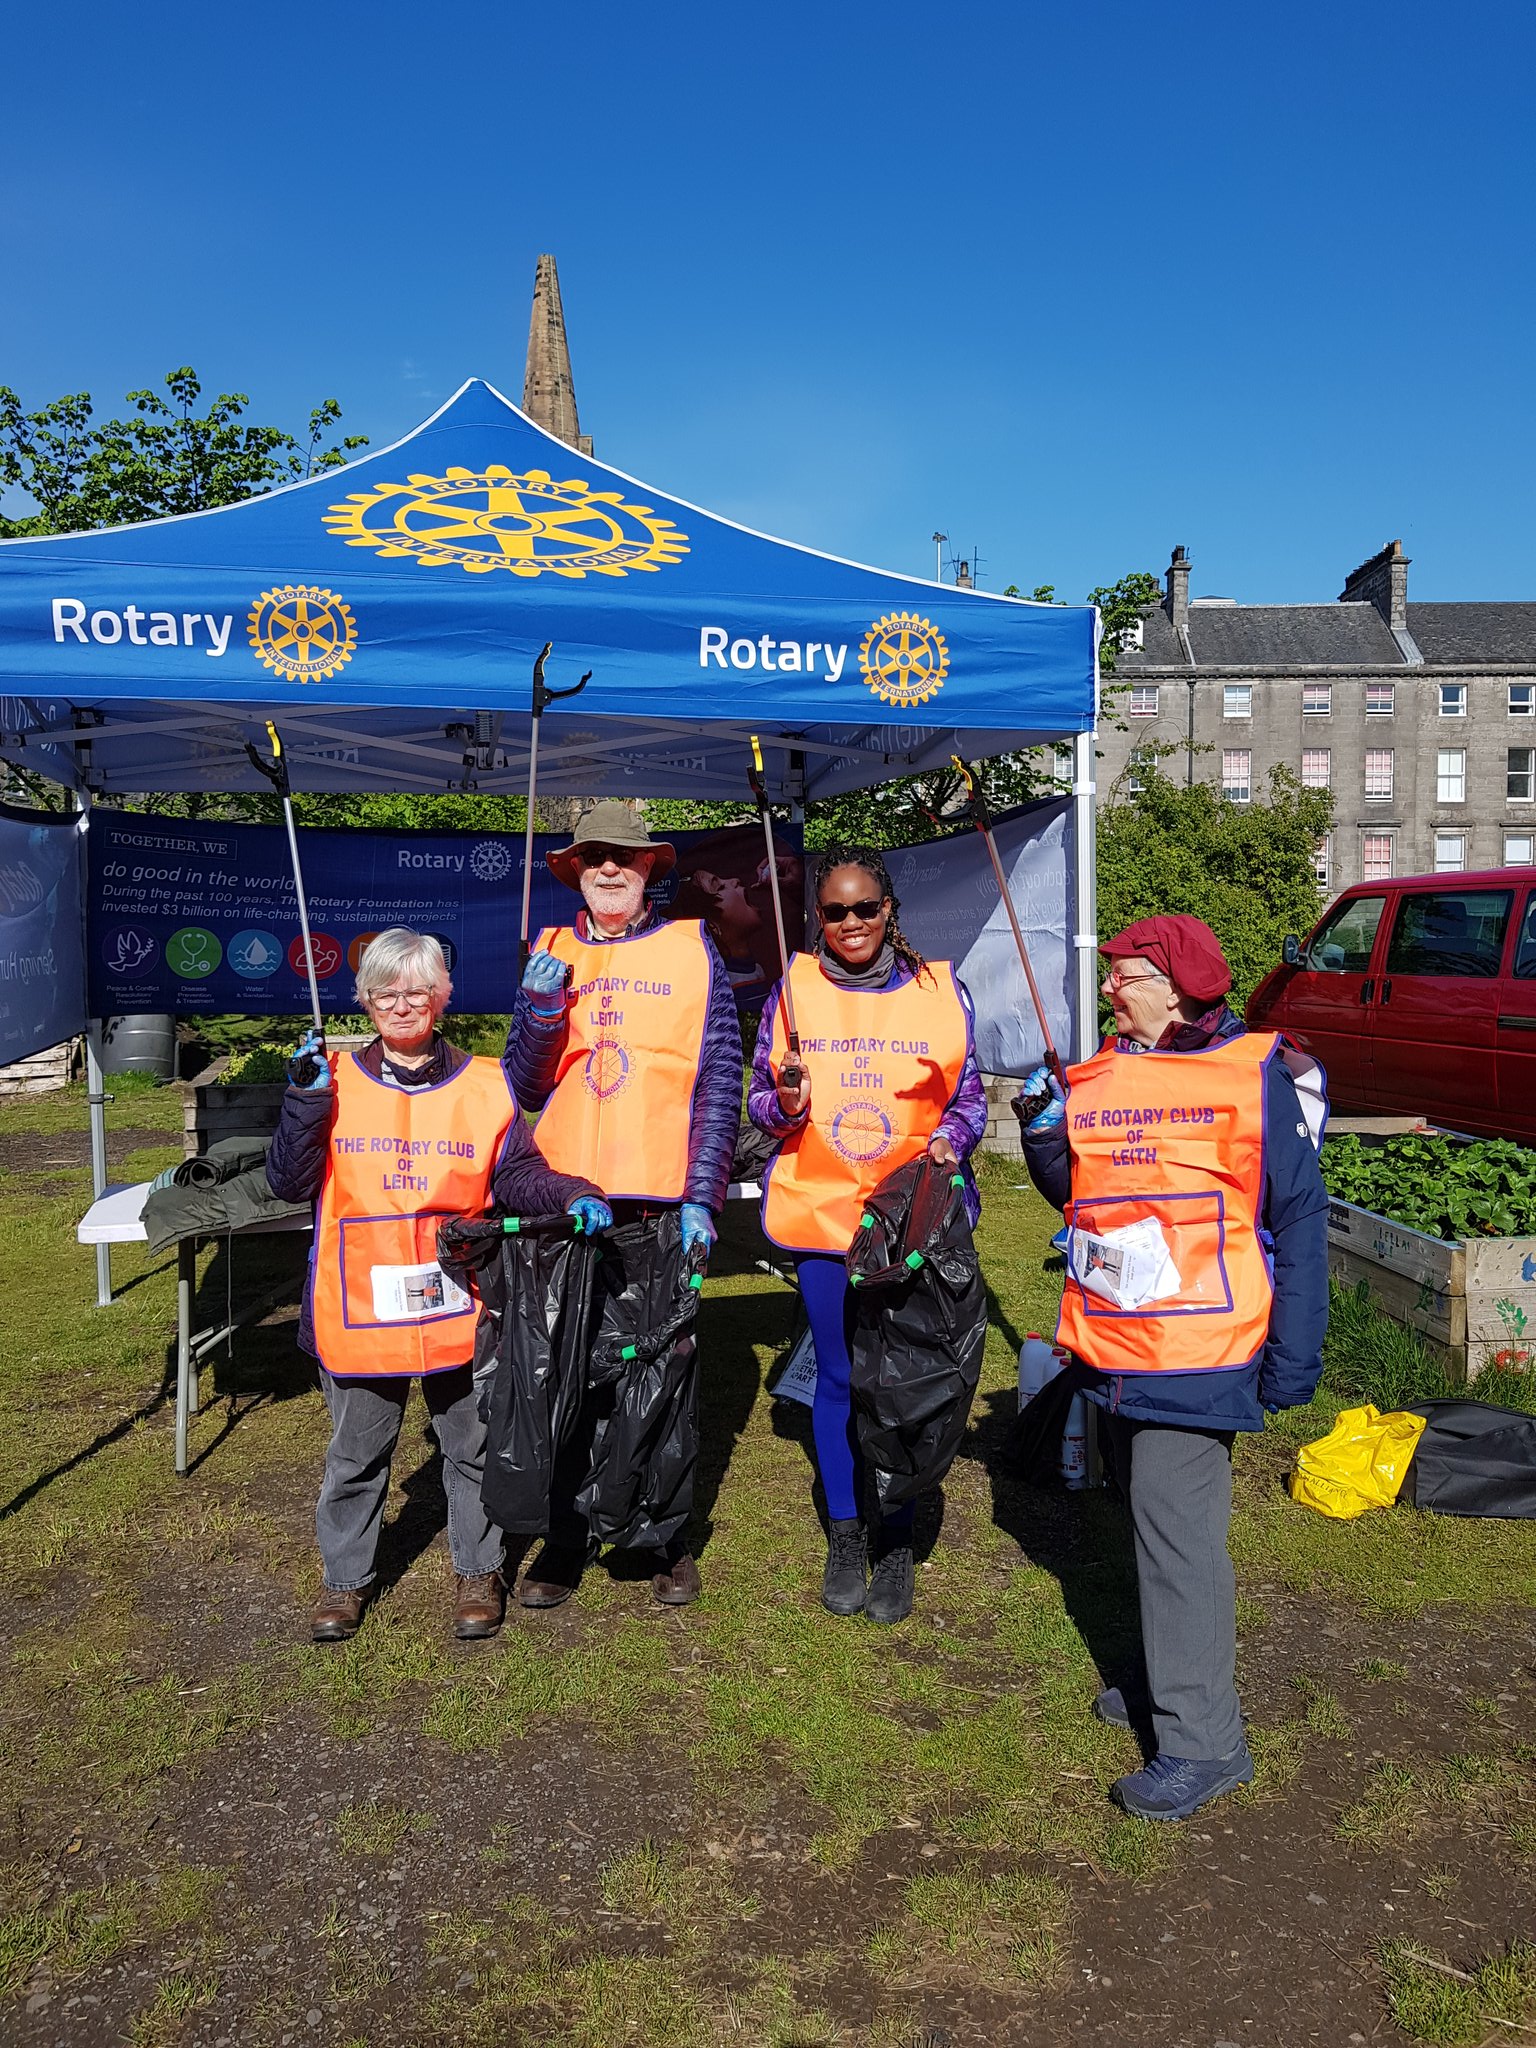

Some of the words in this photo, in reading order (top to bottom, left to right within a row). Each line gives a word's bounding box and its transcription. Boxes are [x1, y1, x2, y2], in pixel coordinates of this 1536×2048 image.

[429, 477, 573, 496] ROTARY
[385, 535, 651, 569] INTERNATIONAL
[278, 591, 326, 602] ROTARY
[51, 598, 233, 657] Rotary
[886, 621, 925, 634] ROTARY
[266, 646, 343, 672] INTERNATIONAL
[699, 626, 848, 683] Rotary
[873, 673, 936, 697] INTERNATIONAL
[110, 832, 200, 853] TOGETHER,
[202, 841, 228, 855] WE
[397, 850, 465, 872] Rotary
[102, 860, 127, 877] do
[132, 866, 182, 882] good
[185, 868, 203, 884] in
[208, 871, 239, 887] the
[102, 884, 147, 899] During
[150, 888, 171, 899] the
[174, 891, 204, 903] past
[208, 892, 233, 903] 100
[235, 895, 275, 906] years,
[281, 895, 301, 905] Th
[309, 896, 354, 910] Rotary
[357, 898, 434, 909] Foundation
[436, 898, 460, 909] has
[102, 900, 158, 915] invested
[161, 903, 178, 916] $3
[182, 905, 220, 918] billion
[223, 909, 240, 919] on
[333, 909, 406, 923] sustainable
[408, 911, 457, 924] projects
[579, 977, 630, 997] ROTARY
[633, 980, 672, 996] CLUB
[601, 995, 613, 1009] OF
[590, 1011, 624, 1027] LEITH
[800, 1039, 827, 1053] THE
[830, 1037, 886, 1053] ROTARY
[890, 1040, 930, 1055] CLUB
[854, 1056, 871, 1069] OF
[840, 1073, 884, 1089] LEITH
[846, 1103, 878, 1111] ROTARY
[1073, 1110, 1097, 1130] THE
[1101, 1108, 1164, 1127] ROTARY
[1169, 1107, 1215, 1124] CLUB
[1126, 1129, 1144, 1144] OF
[335, 1137, 365, 1154] THE
[370, 1137, 432, 1156] ROTARY
[436, 1141, 475, 1159] CLUB
[836, 1142, 888, 1160] INTERNATIONAL
[1112, 1147, 1157, 1167] LEITH
[397, 1158, 414, 1172] OF
[383, 1174, 428, 1191] LEITH
